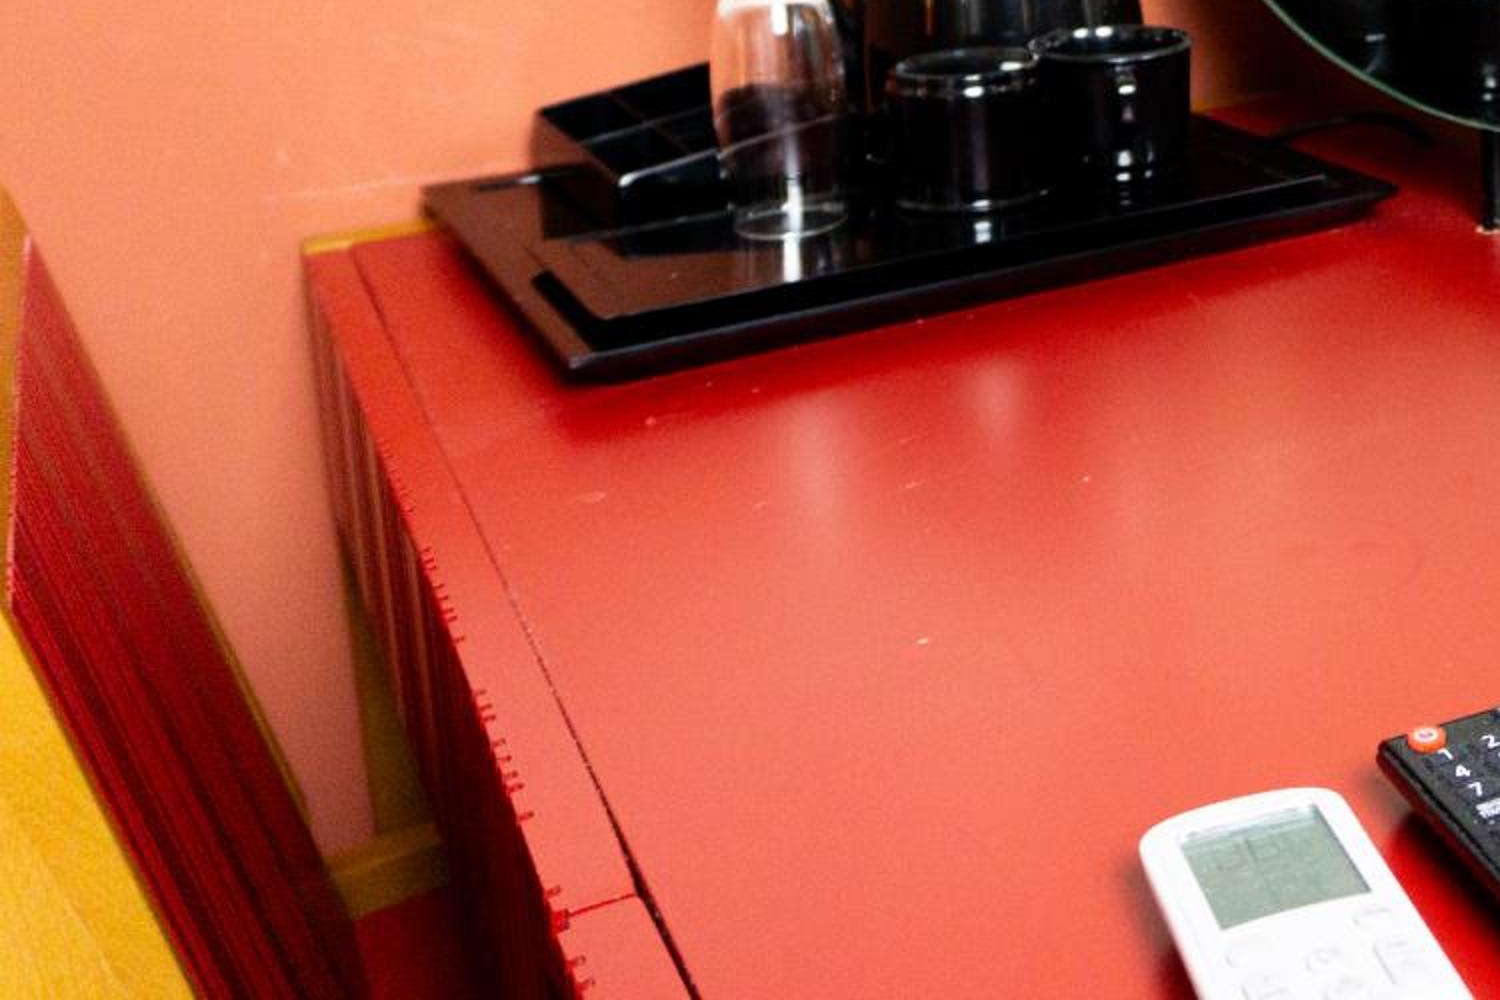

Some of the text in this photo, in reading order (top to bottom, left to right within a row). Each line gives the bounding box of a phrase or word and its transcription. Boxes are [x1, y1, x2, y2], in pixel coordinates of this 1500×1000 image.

[1481, 734, 1500, 748] 2
[1455, 764, 1471, 778] 4
[1468, 781, 1483, 797] 7
